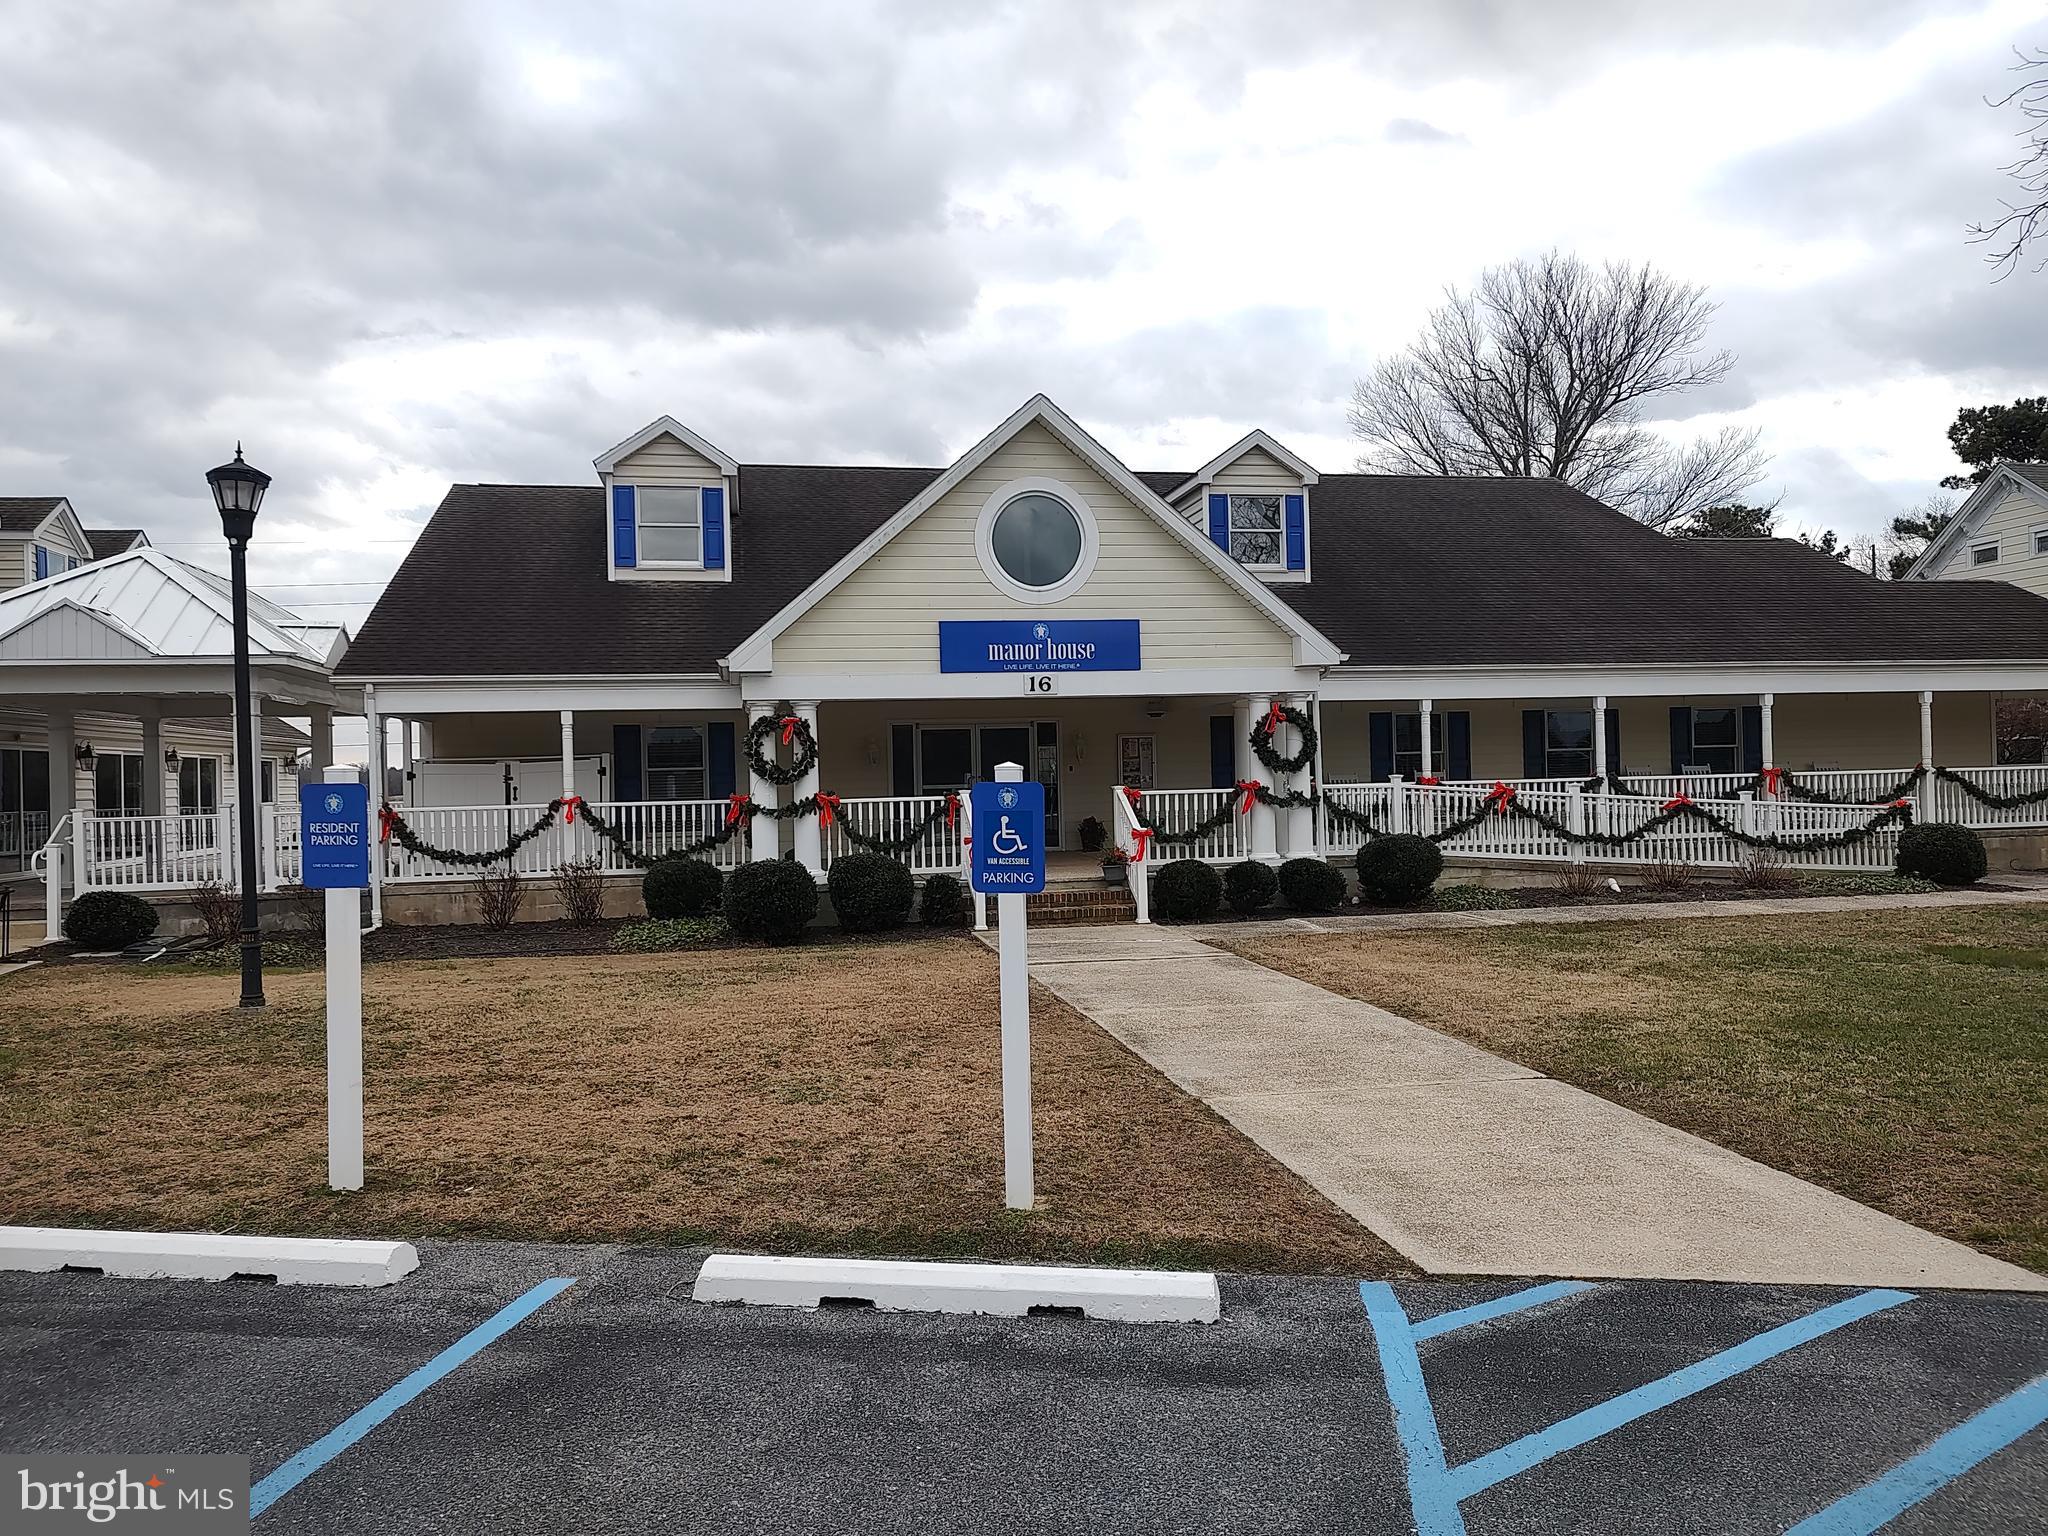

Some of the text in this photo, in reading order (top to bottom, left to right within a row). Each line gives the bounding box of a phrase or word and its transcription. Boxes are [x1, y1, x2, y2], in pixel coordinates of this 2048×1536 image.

[988, 637, 1096, 661] manor house
[1003, 663, 1018, 671] LIVE
[1029, 676, 1052, 692] 16
[309, 823, 359, 833] RESIDENT
[311, 835, 358, 846] PARKING
[987, 857, 1030, 865] VAN ACCESSIBLE
[982, 872, 1035, 884] PARKING
